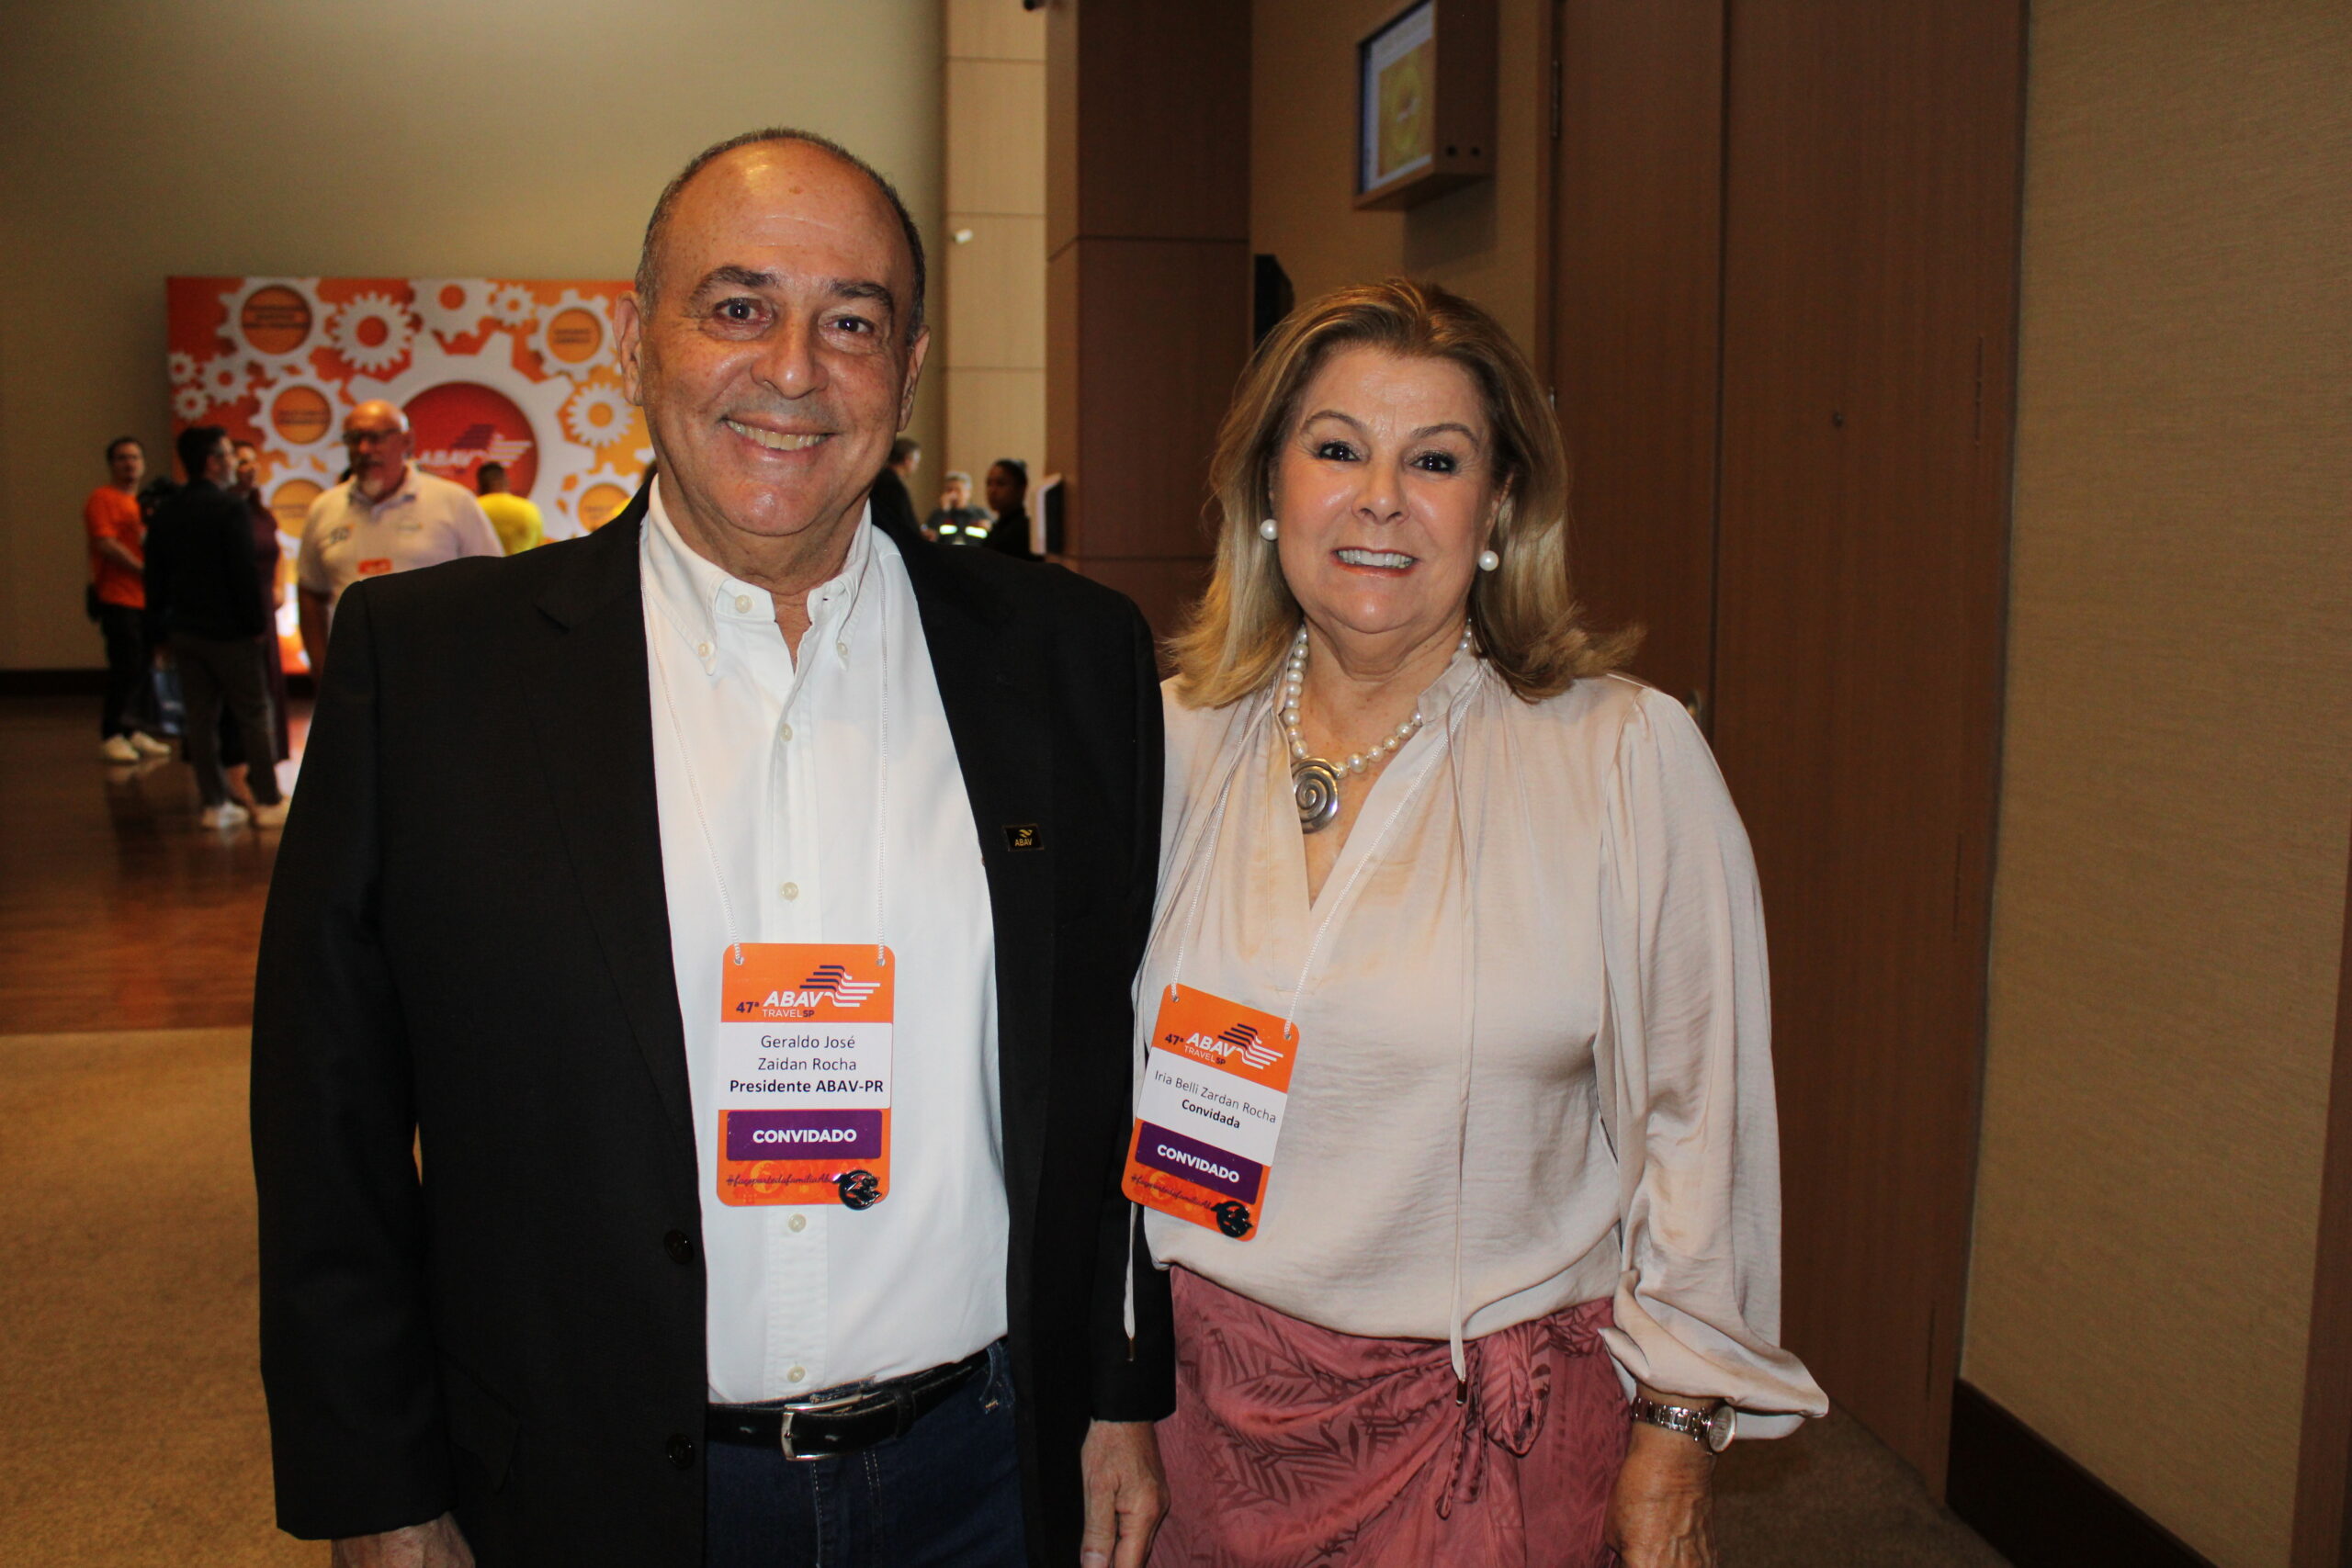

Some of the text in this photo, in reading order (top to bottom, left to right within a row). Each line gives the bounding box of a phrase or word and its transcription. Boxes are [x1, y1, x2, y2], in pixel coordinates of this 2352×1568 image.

[1014, 839, 1033, 847] ABAV
[763, 991, 824, 1008] ABAV
[761, 1035, 855, 1049] Geraldo José
[1186, 1032, 1237, 1057] ABAV
[758, 1057, 856, 1071] Zaidan Rocha
[729, 1079, 884, 1093] Presidente ABAV-PR
[1154, 1070, 1277, 1123] Iria Belli Zardan Rocha
[1182, 1100, 1240, 1129] Convidada
[752, 1129, 857, 1144] CONVIDADO
[1157, 1145, 1239, 1183] CONVIDADO
